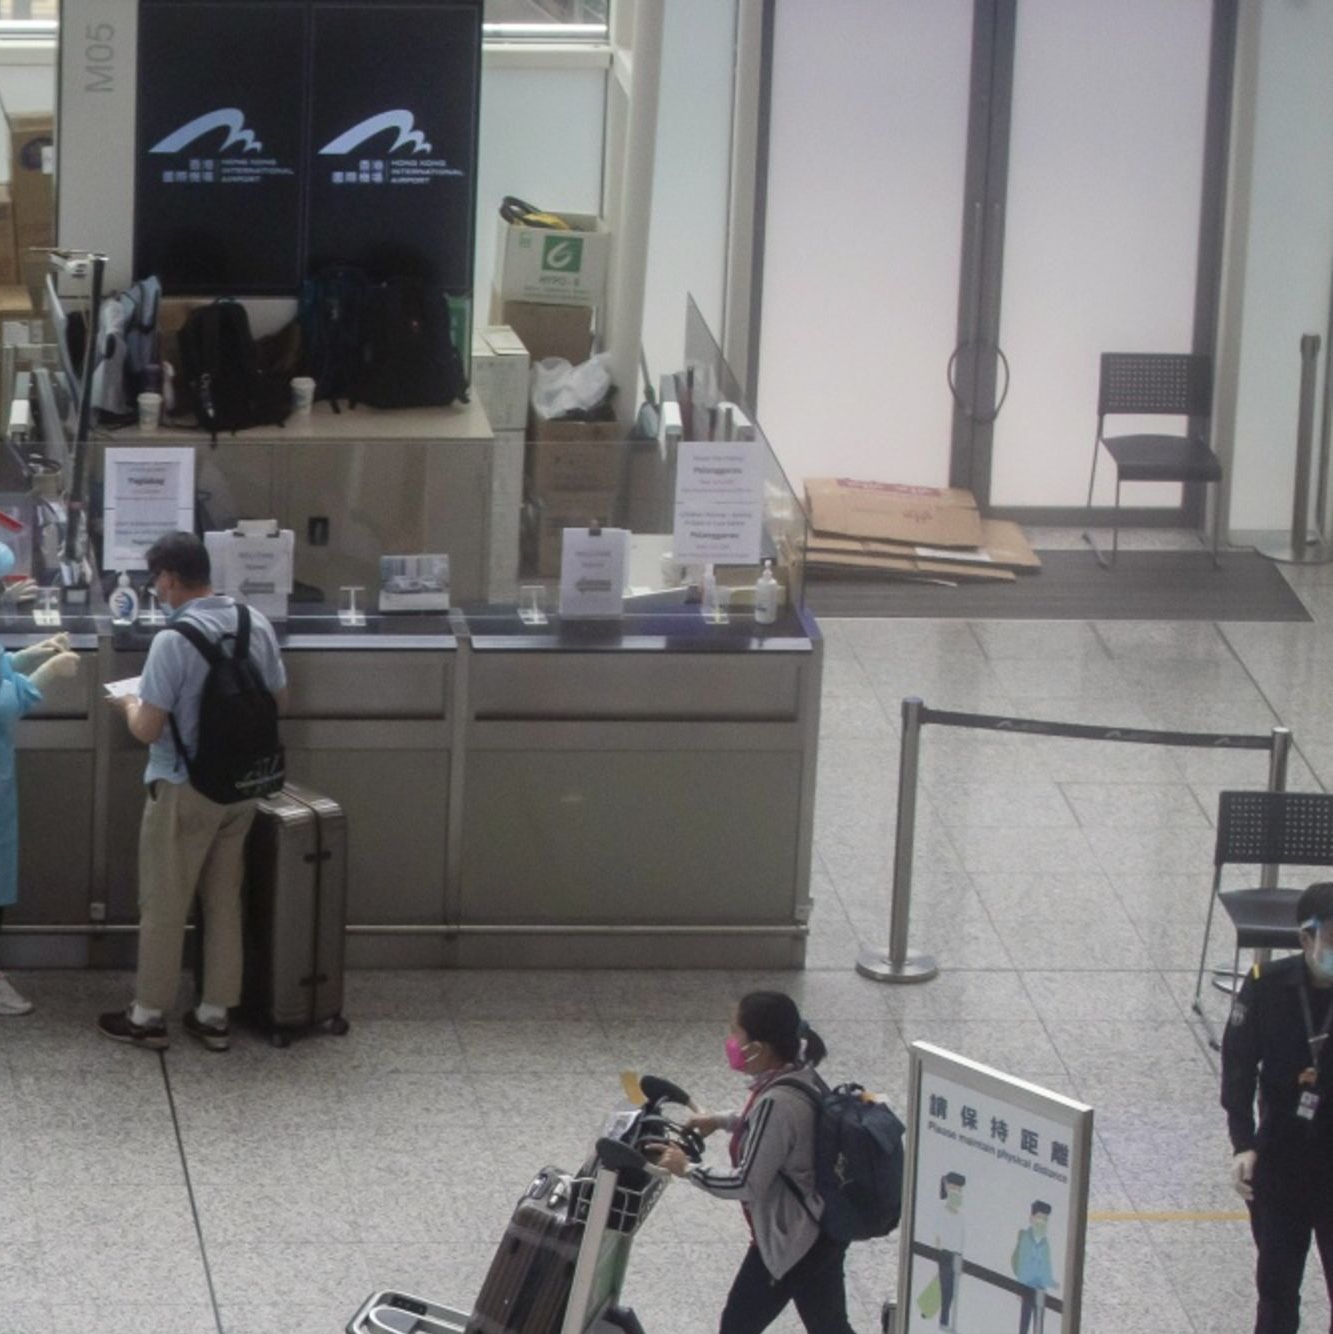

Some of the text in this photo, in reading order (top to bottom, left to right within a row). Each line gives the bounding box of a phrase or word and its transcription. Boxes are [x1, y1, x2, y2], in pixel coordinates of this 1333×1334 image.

[84, 24, 114, 92] M05
[927, 1120, 1067, 1183] Please maintain physical distance
[929, 1093, 1069, 1168] 請保持距離
